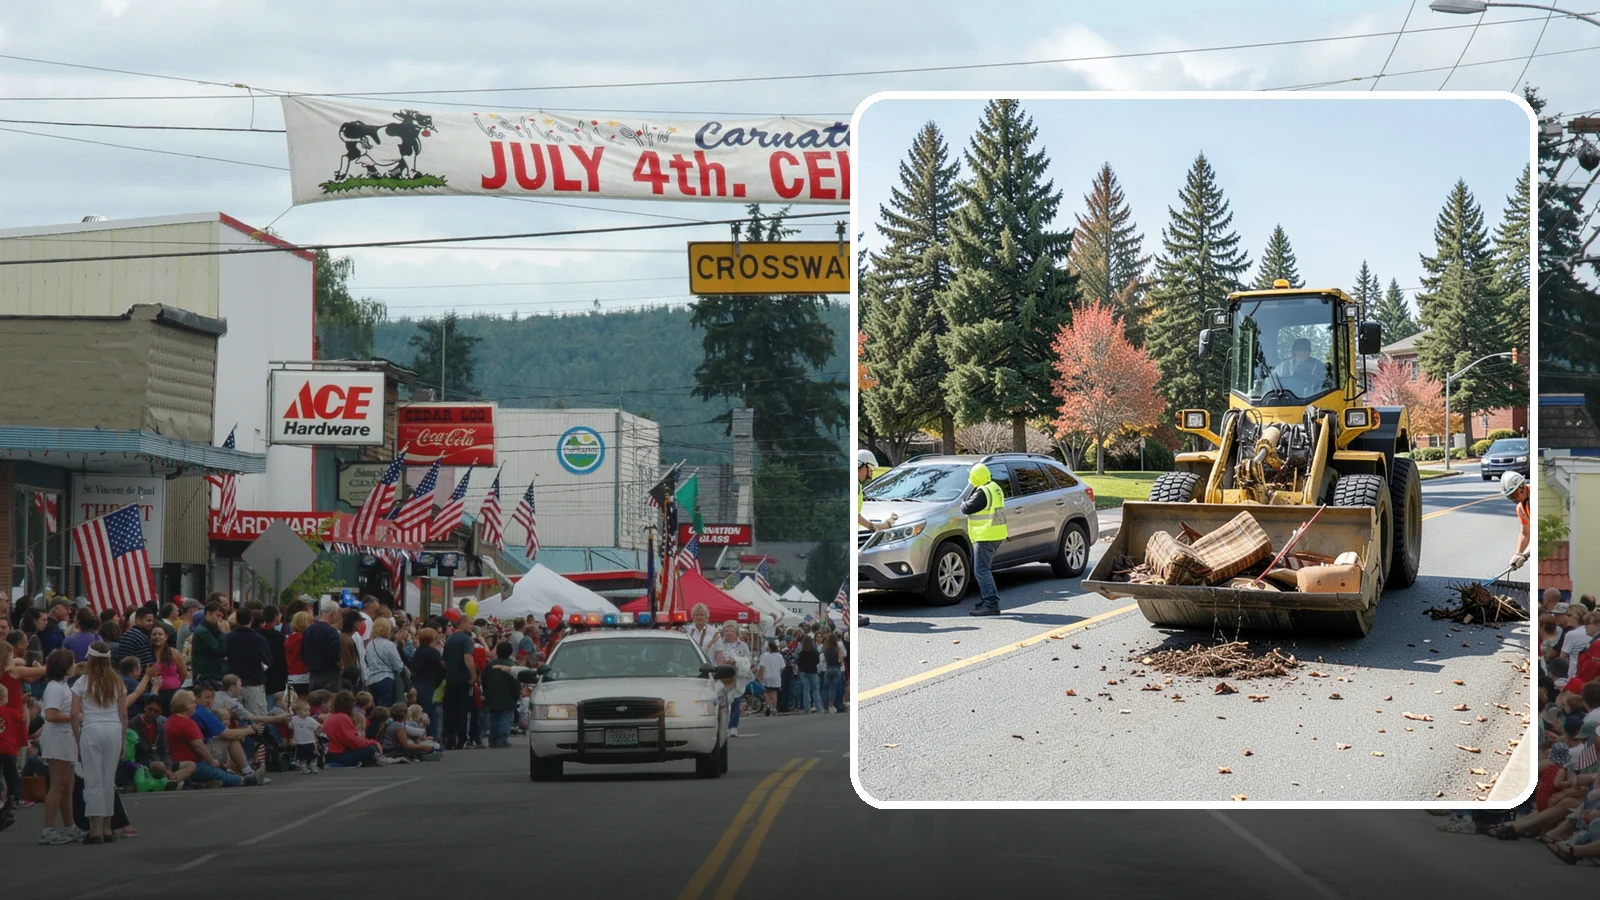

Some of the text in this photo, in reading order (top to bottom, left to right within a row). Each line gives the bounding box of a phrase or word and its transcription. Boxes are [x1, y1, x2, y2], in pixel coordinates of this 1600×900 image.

[695, 121, 850, 150] Carnat
[481, 141, 605, 192] JULY
[632, 150, 746, 198] 4th.
[697, 254, 850, 280] CROSSWA
[282, 380, 374, 420] ACE
[405, 409, 453, 422] CEDAR
[283, 421, 371, 437] Hardware
[416, 428, 477, 447] Coca-Cola
[83, 484, 155, 495] St. Vincent de Paul
[688, 526, 742, 535] CRNATION
[699, 535, 730, 543] GLASS
